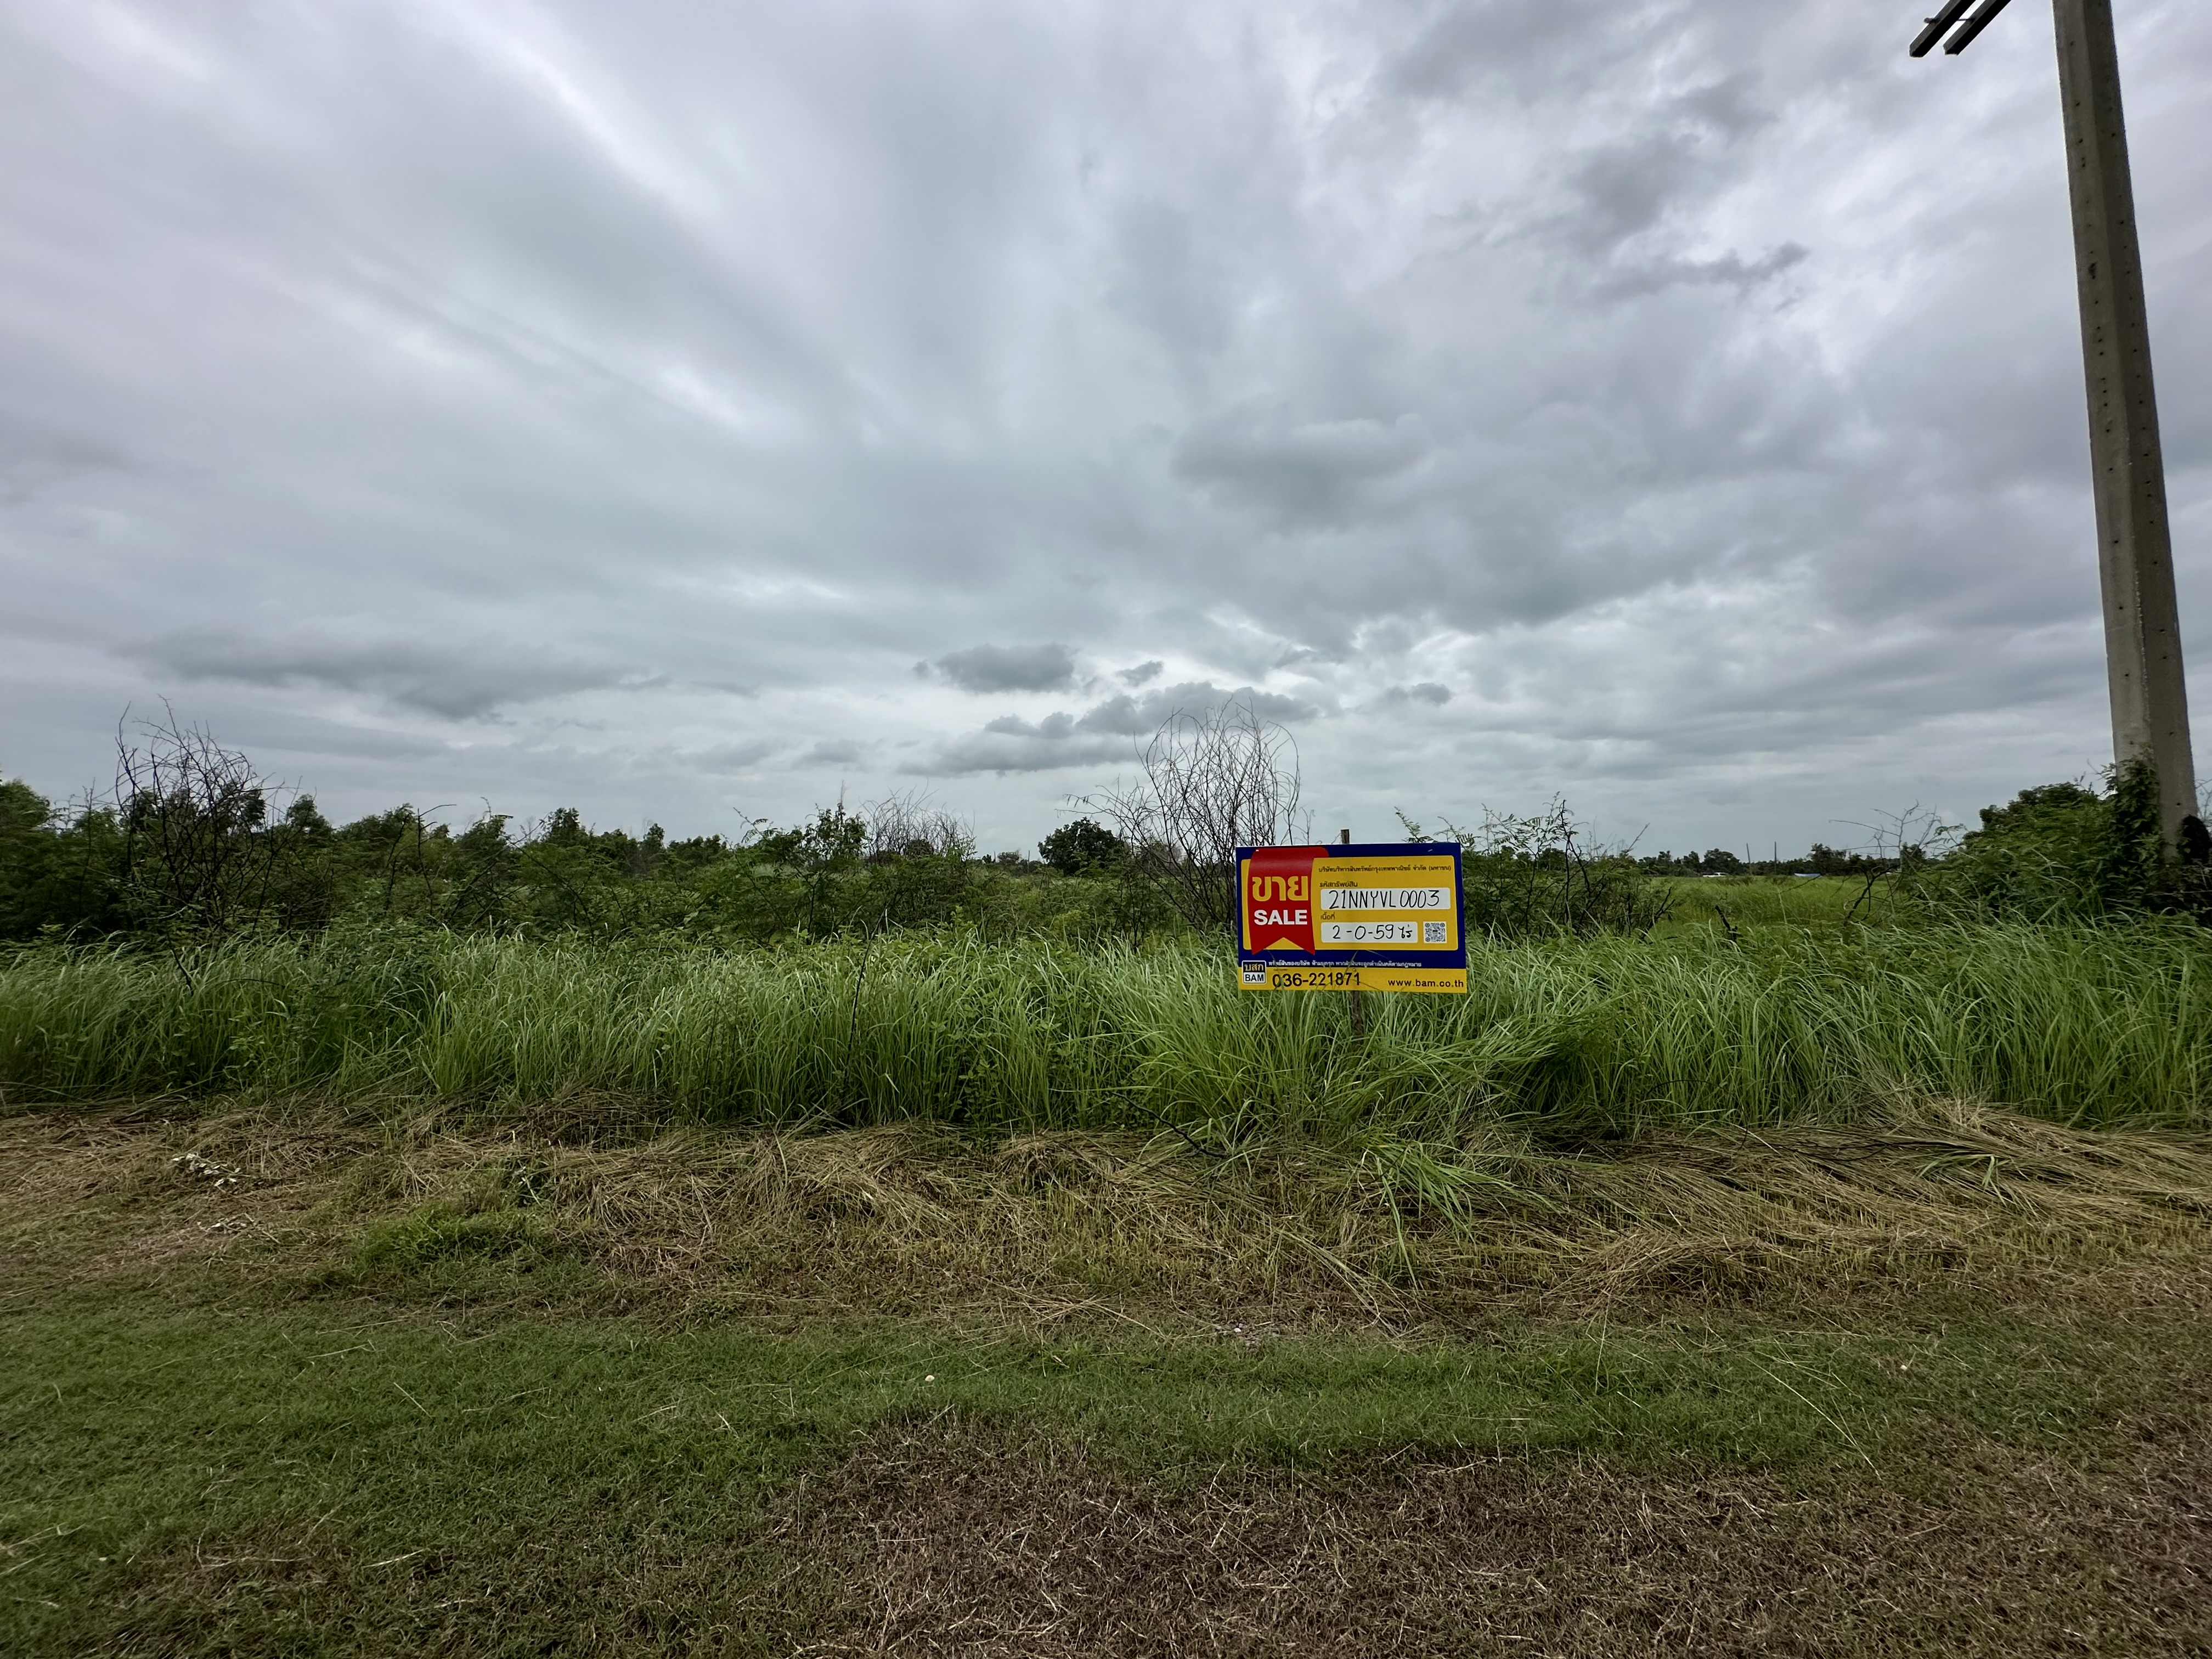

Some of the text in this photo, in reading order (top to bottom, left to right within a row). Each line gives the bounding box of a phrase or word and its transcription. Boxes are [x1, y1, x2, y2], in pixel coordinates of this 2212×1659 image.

[1252, 876, 1308, 901] ขาย
[1329, 889, 1440, 909] 21NNYVL0003
[1254, 910, 1308, 926] SALE
[1321, 912, 1335, 920] เนื้อที่
[1272, 973, 1360, 988] 036-221871
[1387, 978, 1464, 988] www.bam.co.th
